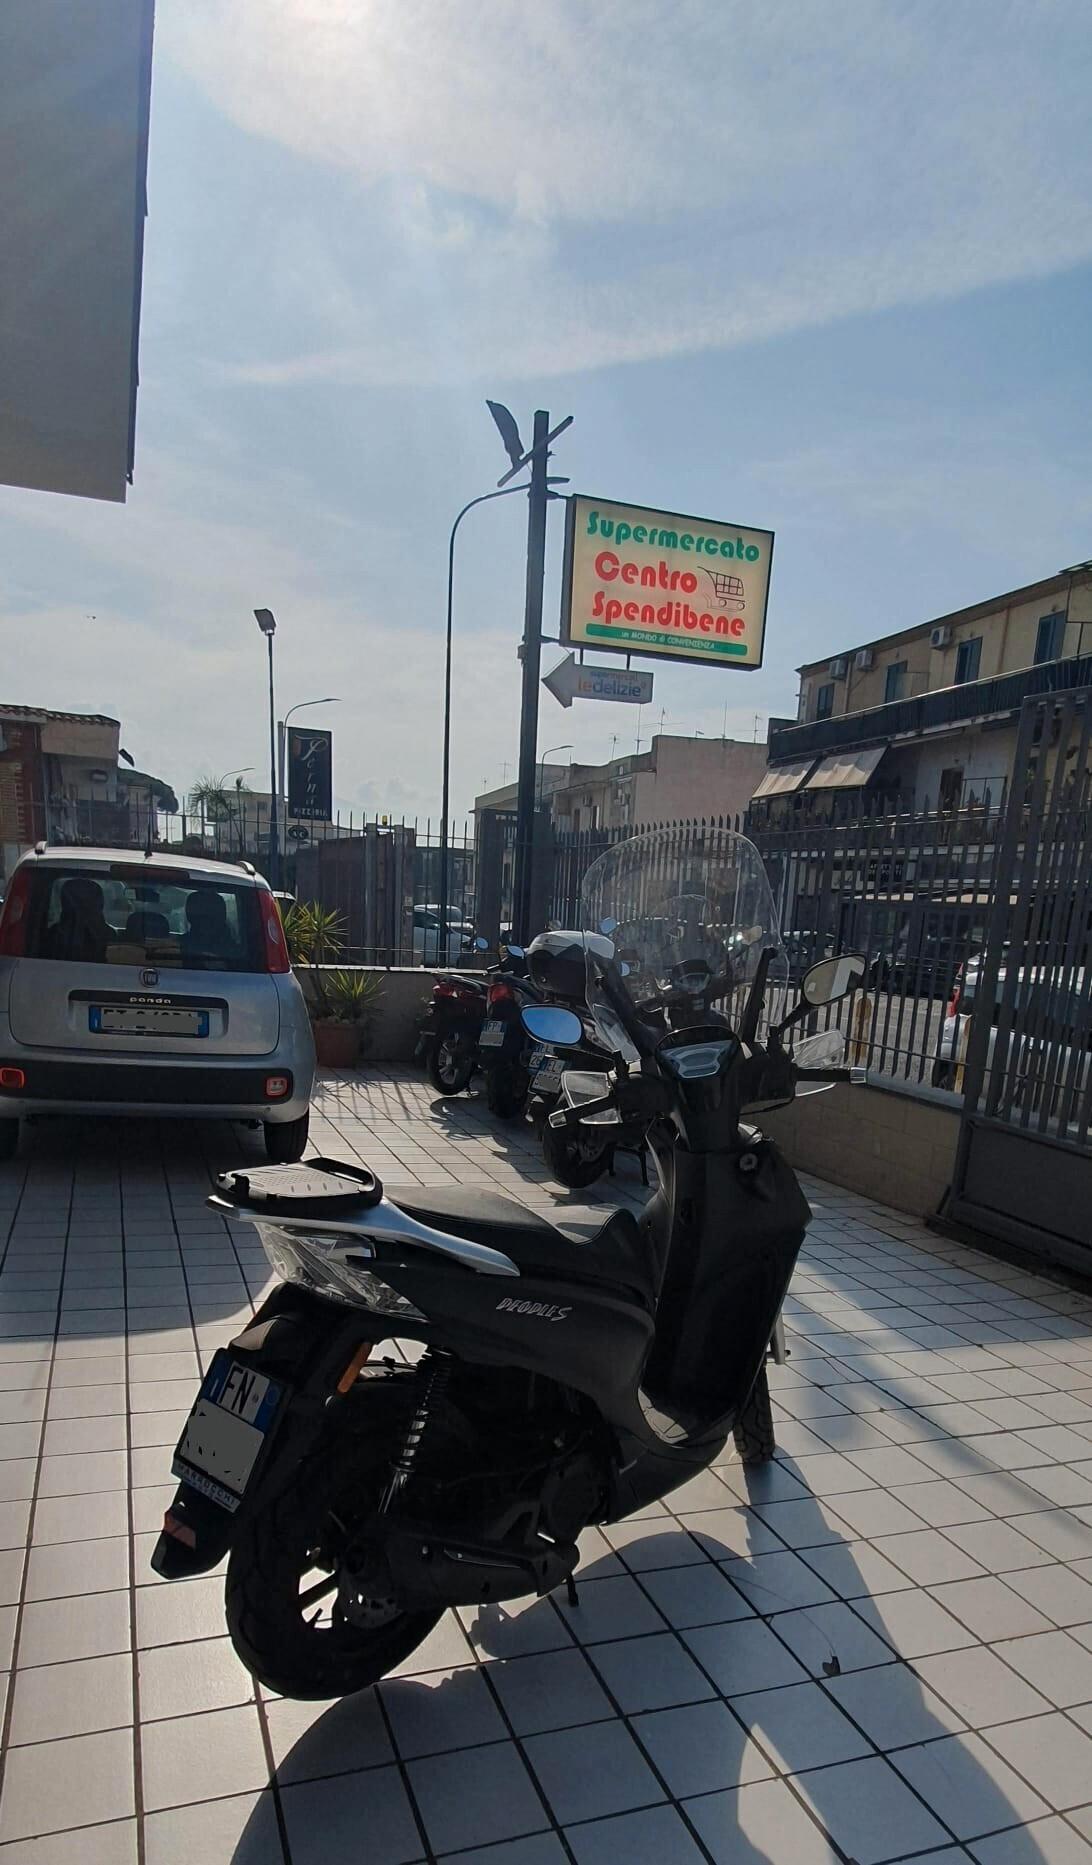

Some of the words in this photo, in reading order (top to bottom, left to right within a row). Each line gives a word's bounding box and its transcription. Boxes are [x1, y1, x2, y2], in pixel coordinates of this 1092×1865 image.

[587, 511, 760, 562] Supermercato
[595, 551, 698, 593] Centro
[592, 591, 746, 637] Spendibene
[631, 631, 657, 642] MONDO
[129, 996, 172, 1004] panda
[218, 1365, 256, 1415] FN
